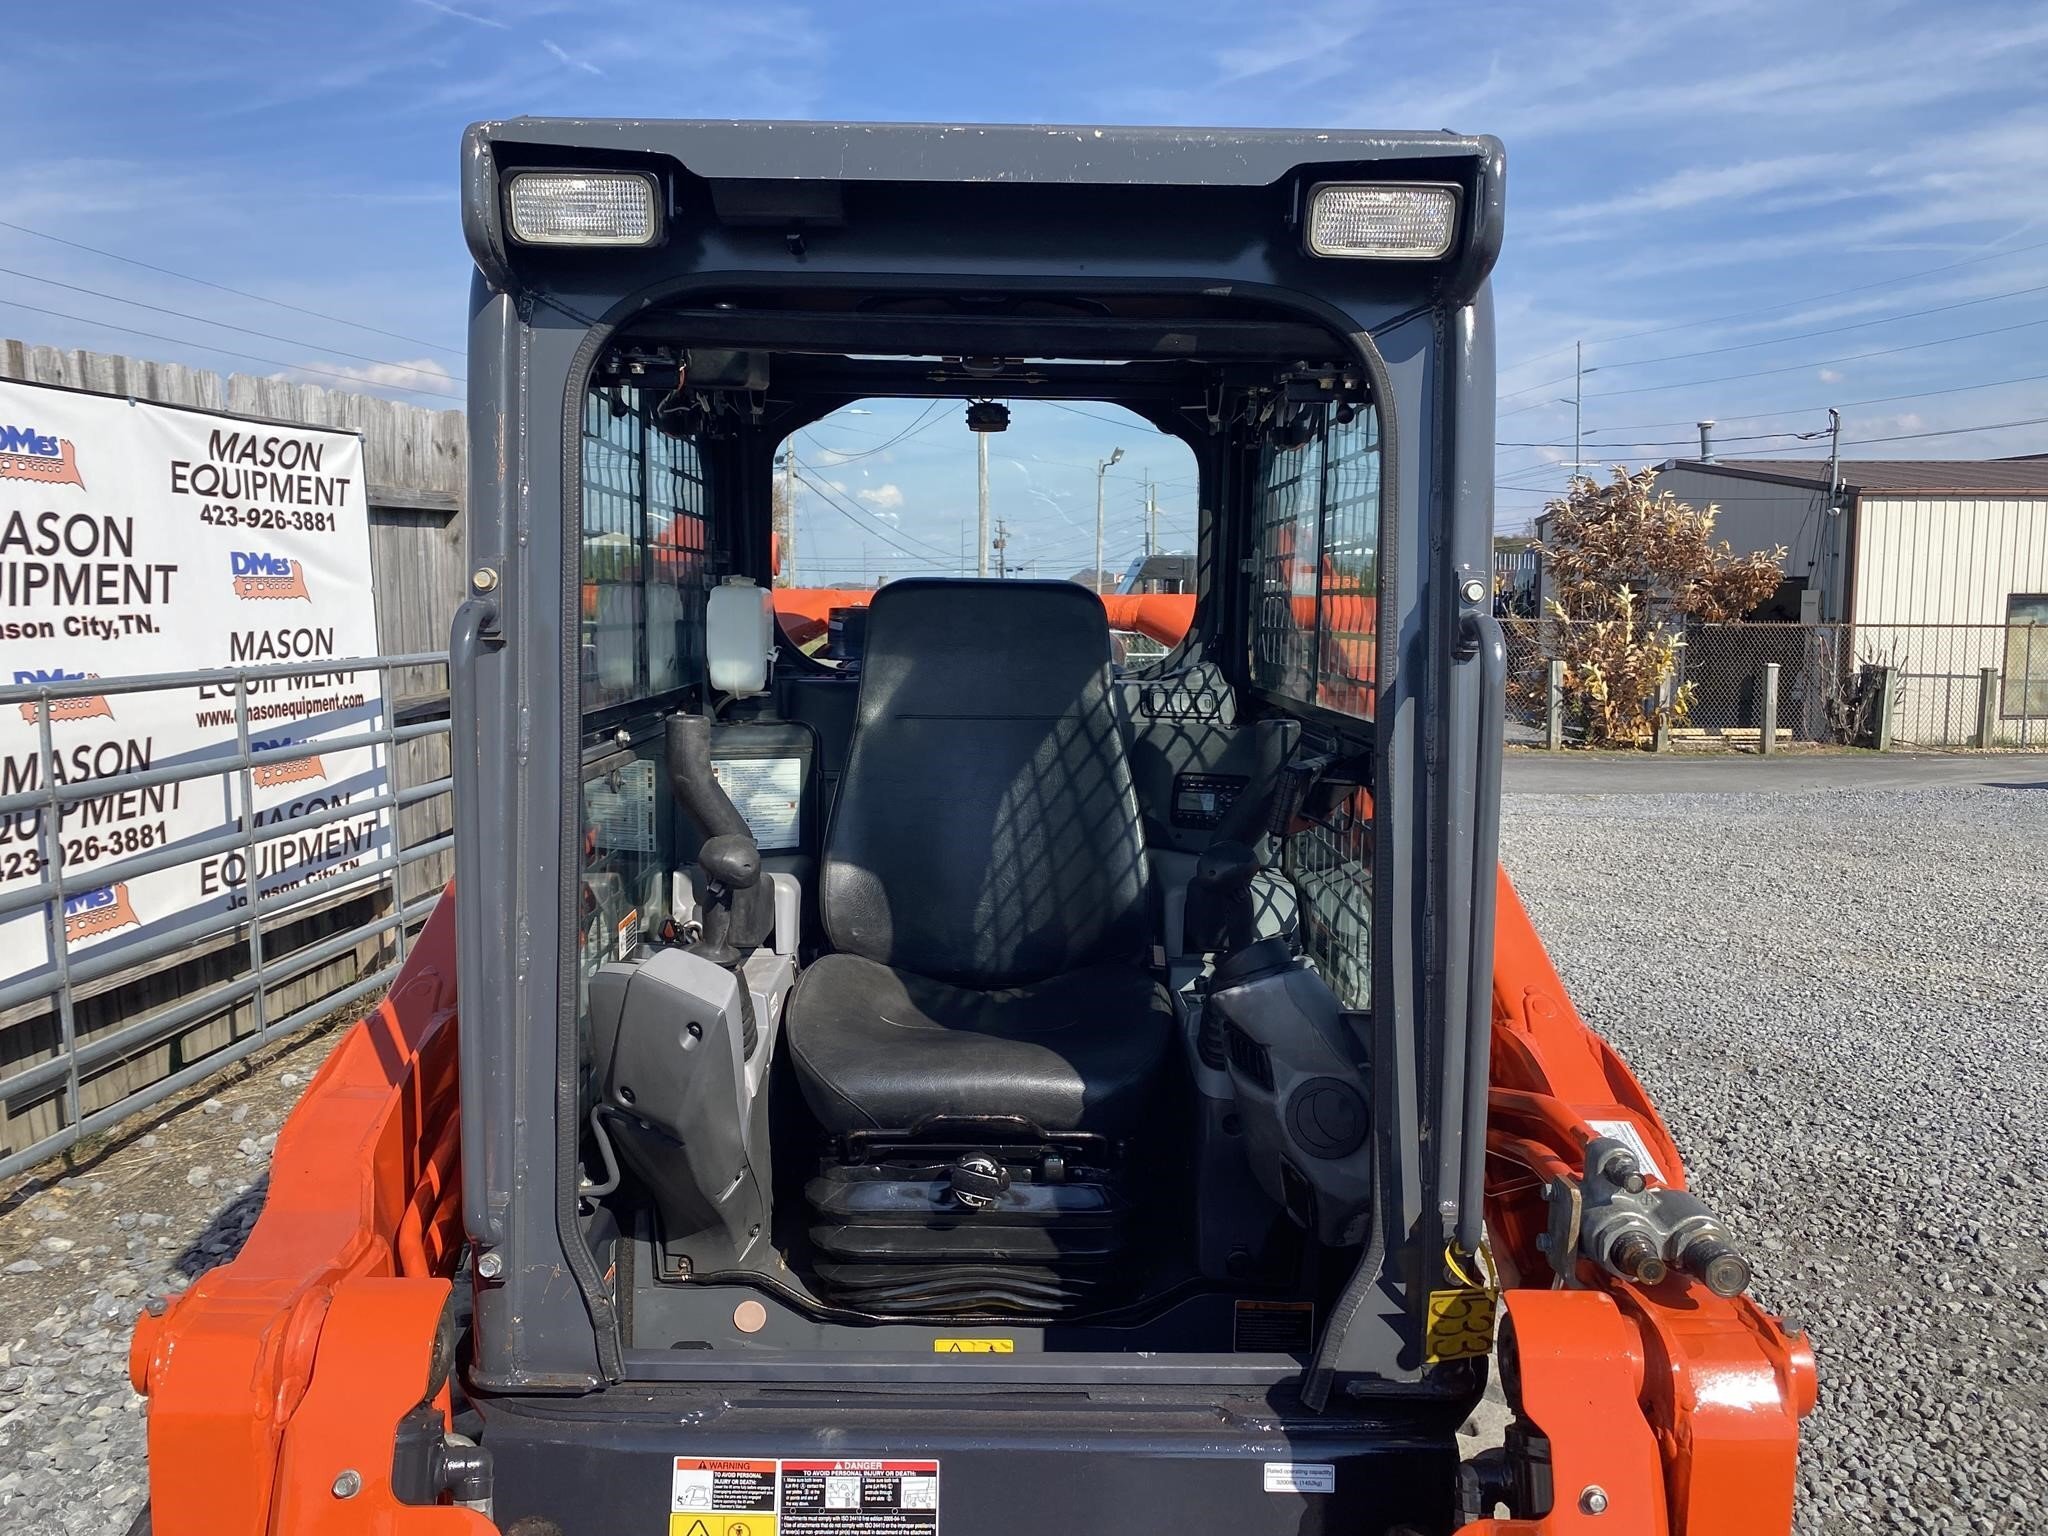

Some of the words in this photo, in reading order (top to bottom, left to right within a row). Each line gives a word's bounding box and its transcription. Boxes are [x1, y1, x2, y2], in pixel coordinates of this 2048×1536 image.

[209, 429, 324, 472] MASON
[171, 460, 351, 507] EQUIPMENT
[0, 510, 133, 557] ASON
[200, 503, 336, 532] 423-926-3881
[0, 562, 178, 606] IPMENT
[0, 621, 55, 640] son
[63, 614, 160, 640] City,TN.
[231, 627, 334, 662] MASON
[196, 693, 364, 728] www.masonequipment.com
[2, 737, 152, 796] MASON
[0, 782, 180, 845] UPMENT
[0, 820, 167, 882] 23-26-3881
[201, 818, 378, 896] EQUIPMENT
[226, 880, 300, 912] Jonson
[709, 1461, 750, 1470] WARNING
[844, 1462, 883, 1470] DANGER
